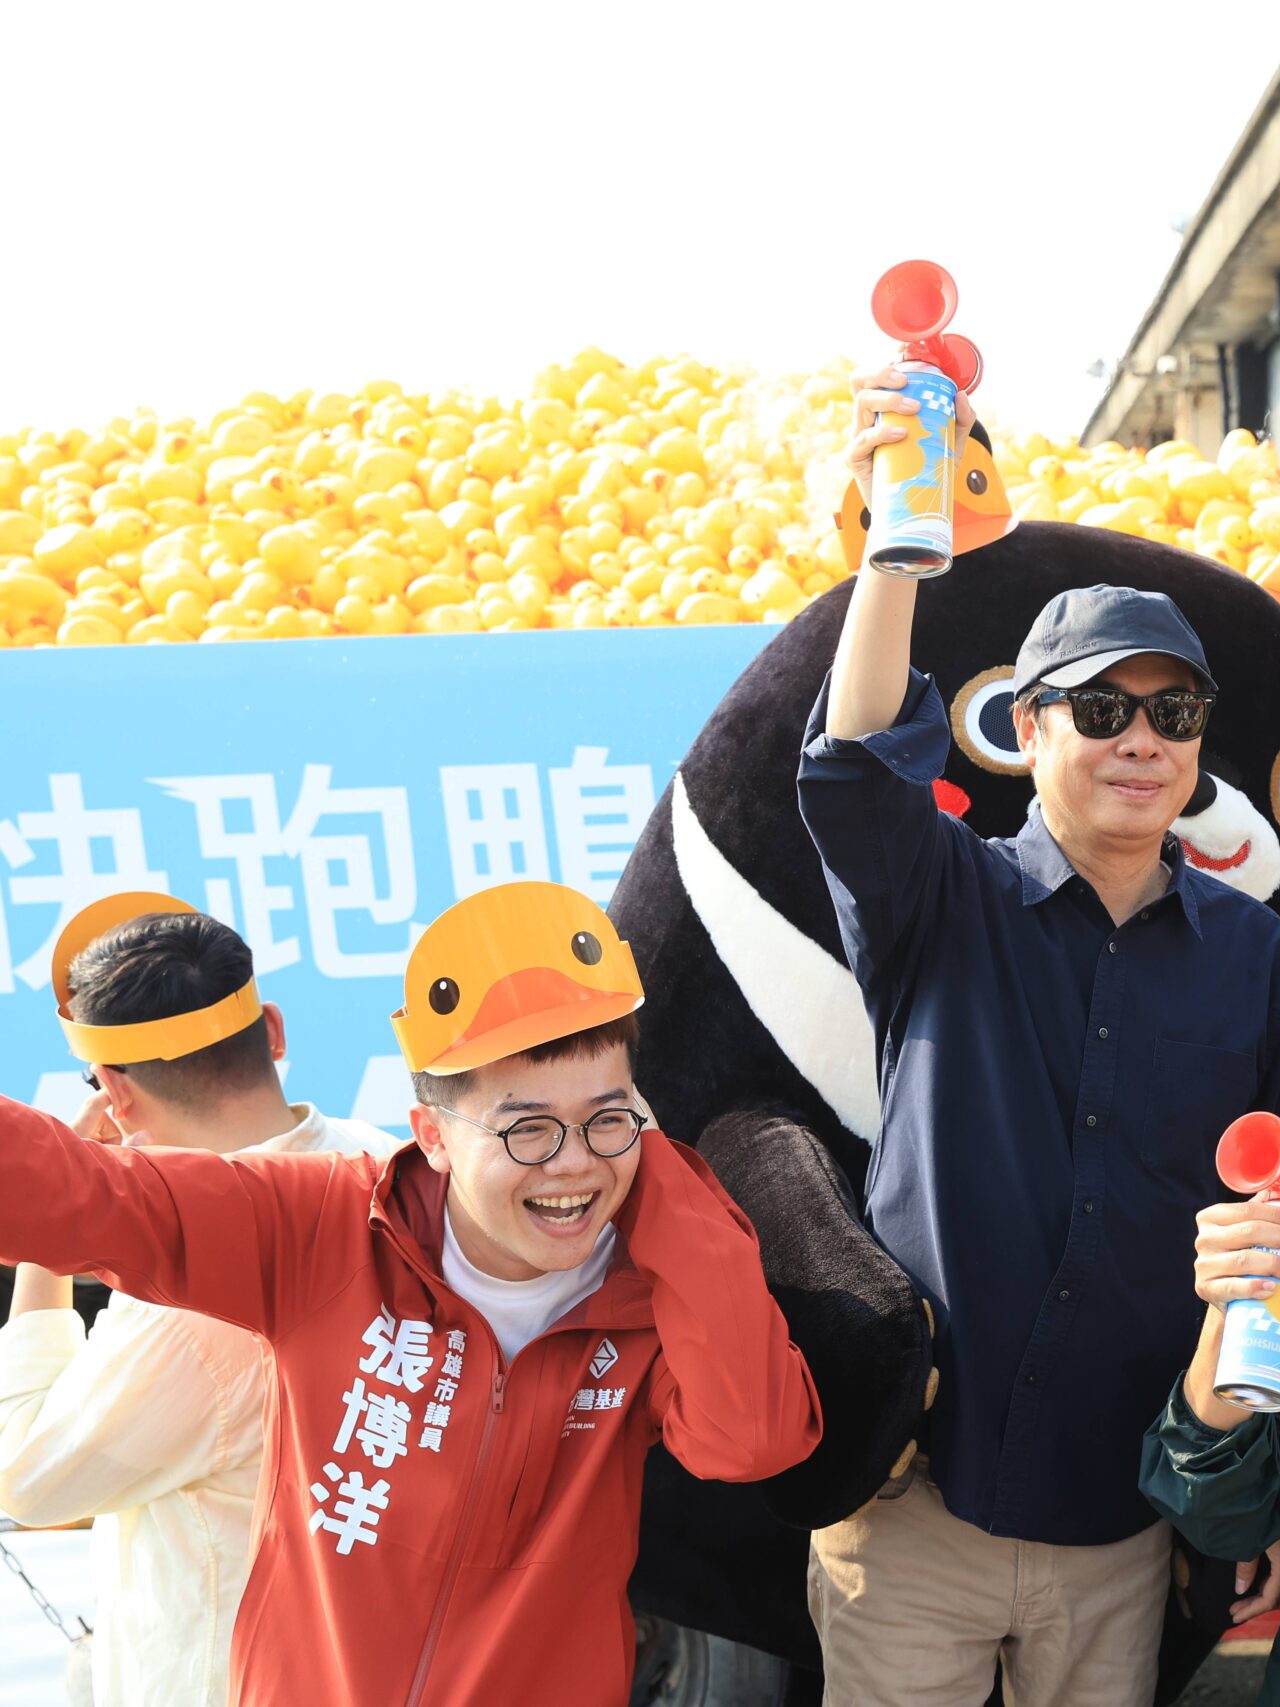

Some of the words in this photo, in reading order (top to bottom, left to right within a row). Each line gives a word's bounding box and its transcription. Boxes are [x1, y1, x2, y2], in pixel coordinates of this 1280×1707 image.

[308, 1302, 435, 1556] 張博洋
[417, 1329, 467, 1453] 高雄市議員
